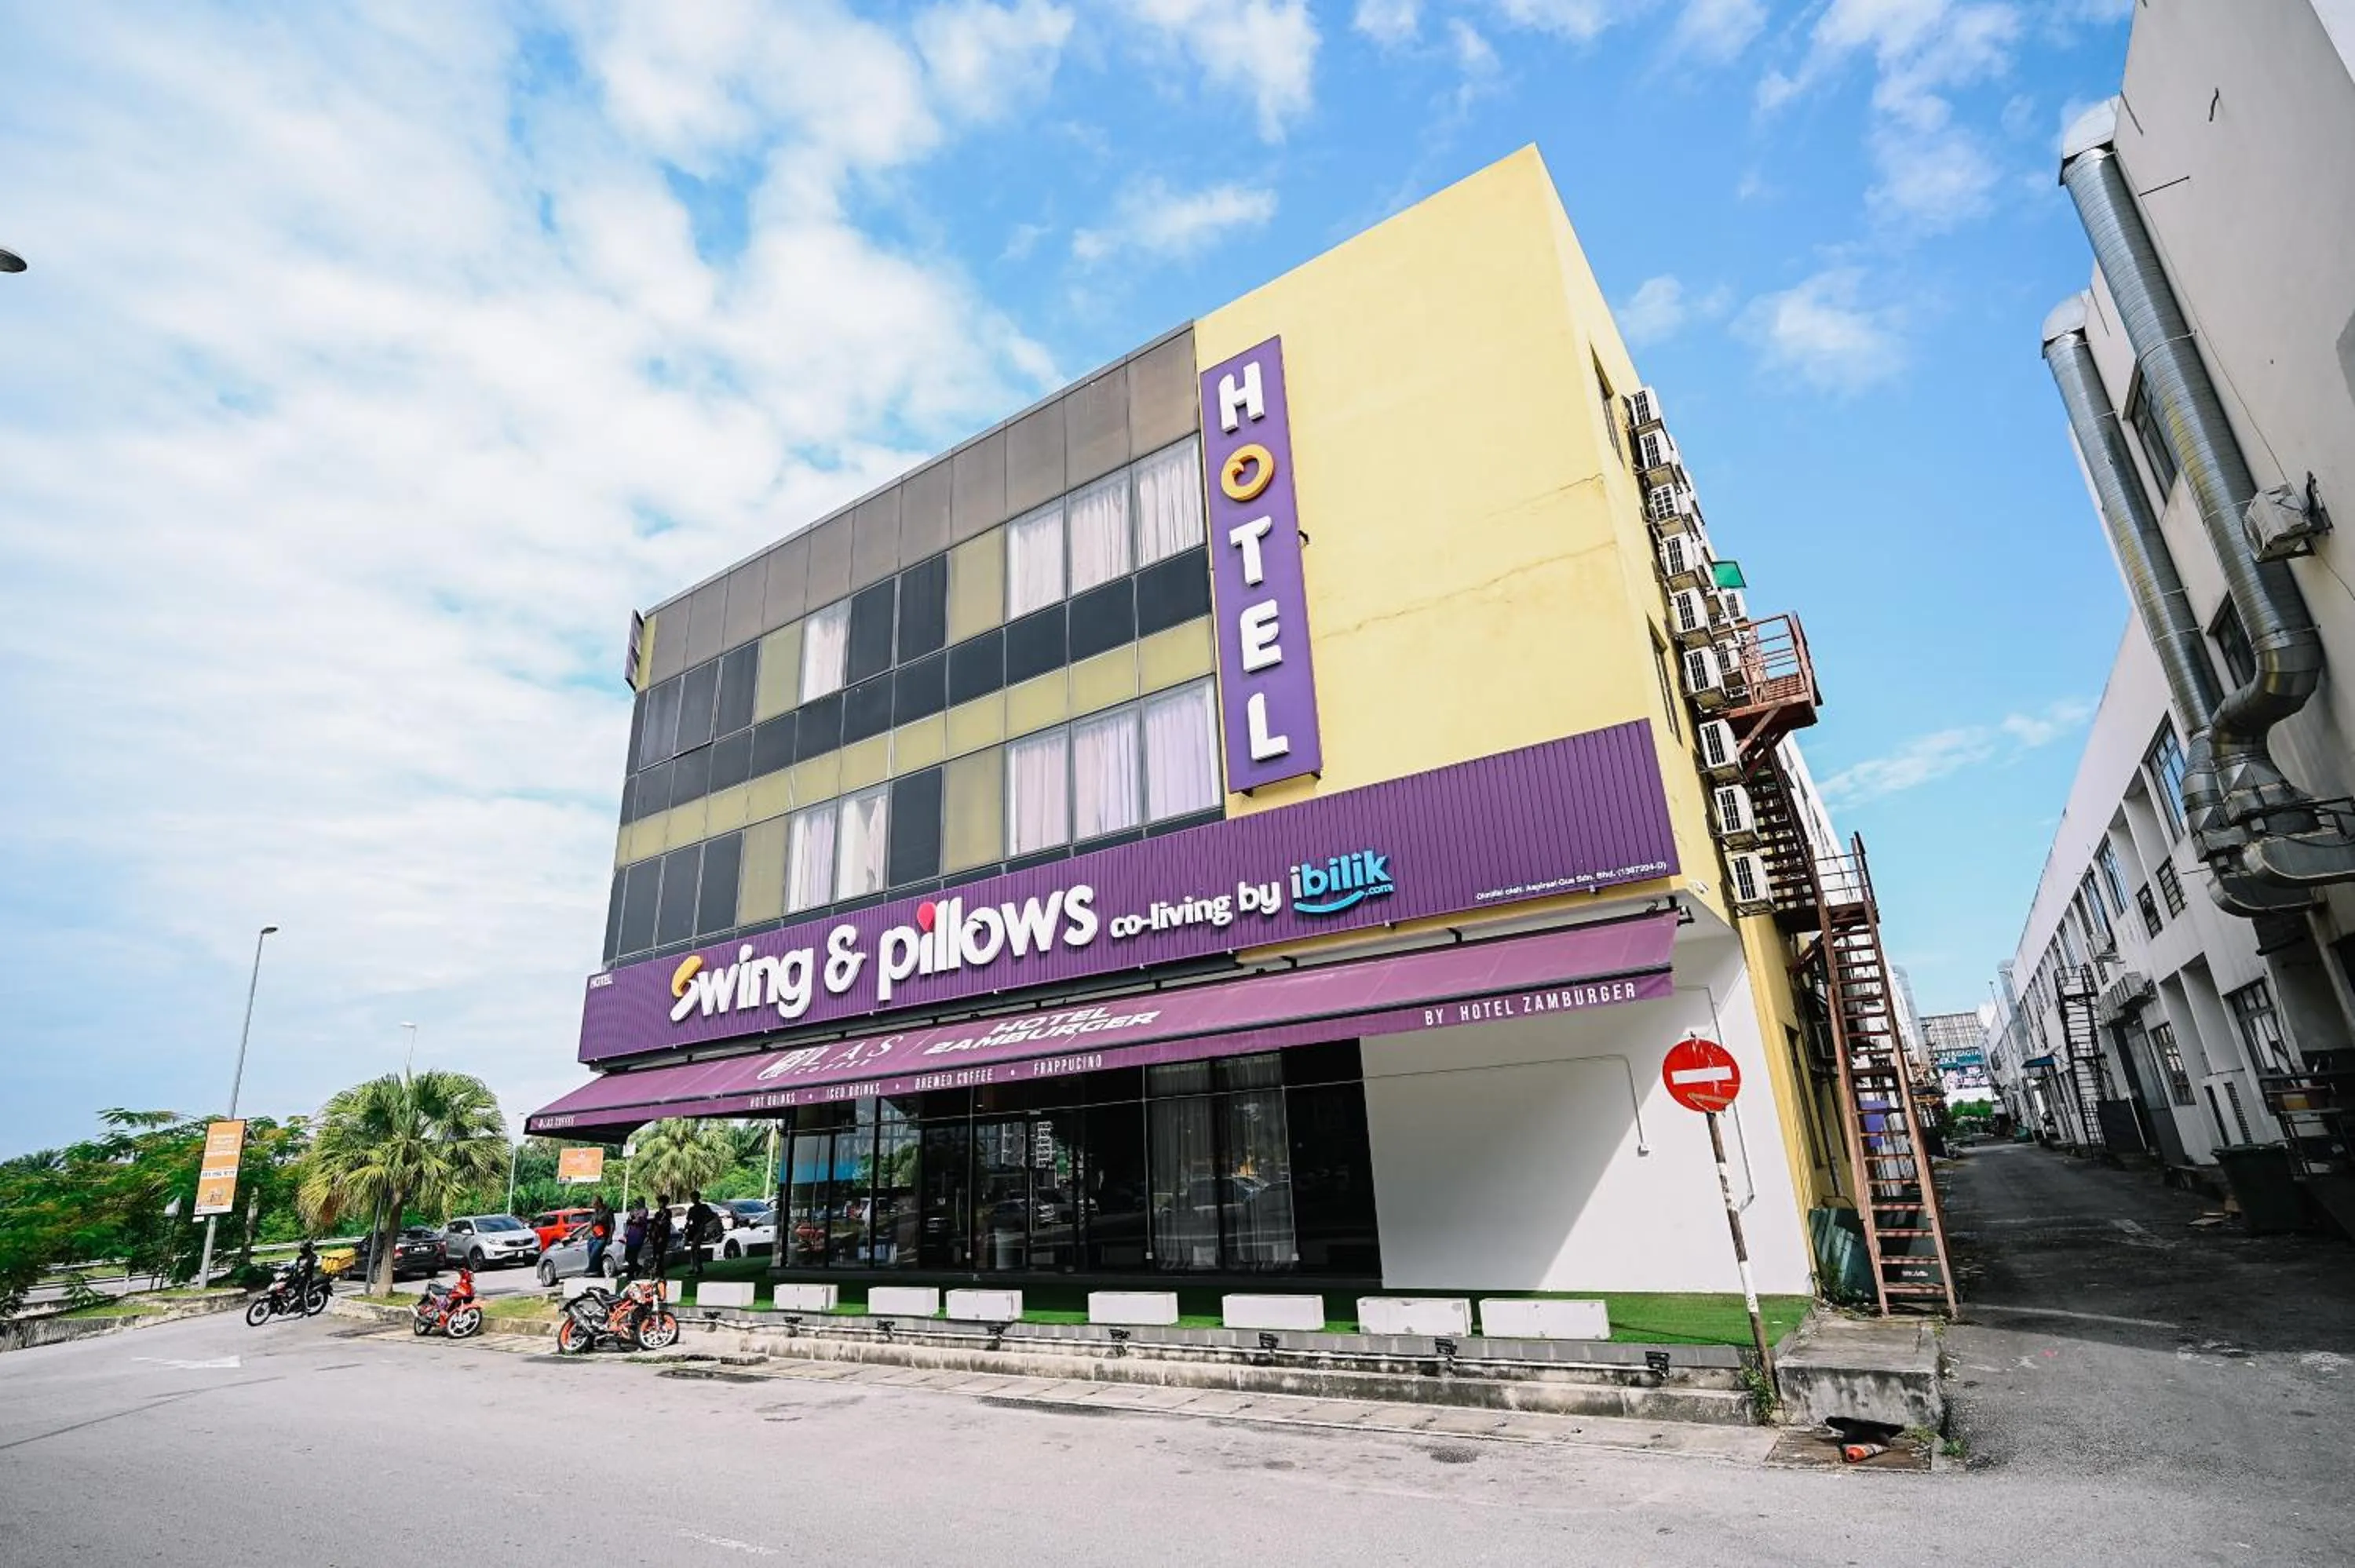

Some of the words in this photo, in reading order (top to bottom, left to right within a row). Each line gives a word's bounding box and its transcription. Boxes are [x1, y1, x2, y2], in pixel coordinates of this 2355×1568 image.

[1218, 360, 1290, 761] HOTEL
[1110, 895, 1234, 939] co-living
[1238, 881, 1283, 915] by
[1290, 849, 1393, 899] ibilik
[823, 924, 867, 994] &
[878, 884, 1099, 1001] pillows
[989, 1007, 1111, 1035] HOTEL
[1424, 1008, 1444, 1026] BY
[1459, 999, 1514, 1021] HOTEL
[1522, 982, 1637, 1013] ZAMBURGER
[922, 1011, 1161, 1055] ZAMBURGER
[915, 1074, 952, 1091] BREWED
[956, 1068, 994, 1085] COFFEE
[1033, 1053, 1102, 1076] FRAPPUCINO
